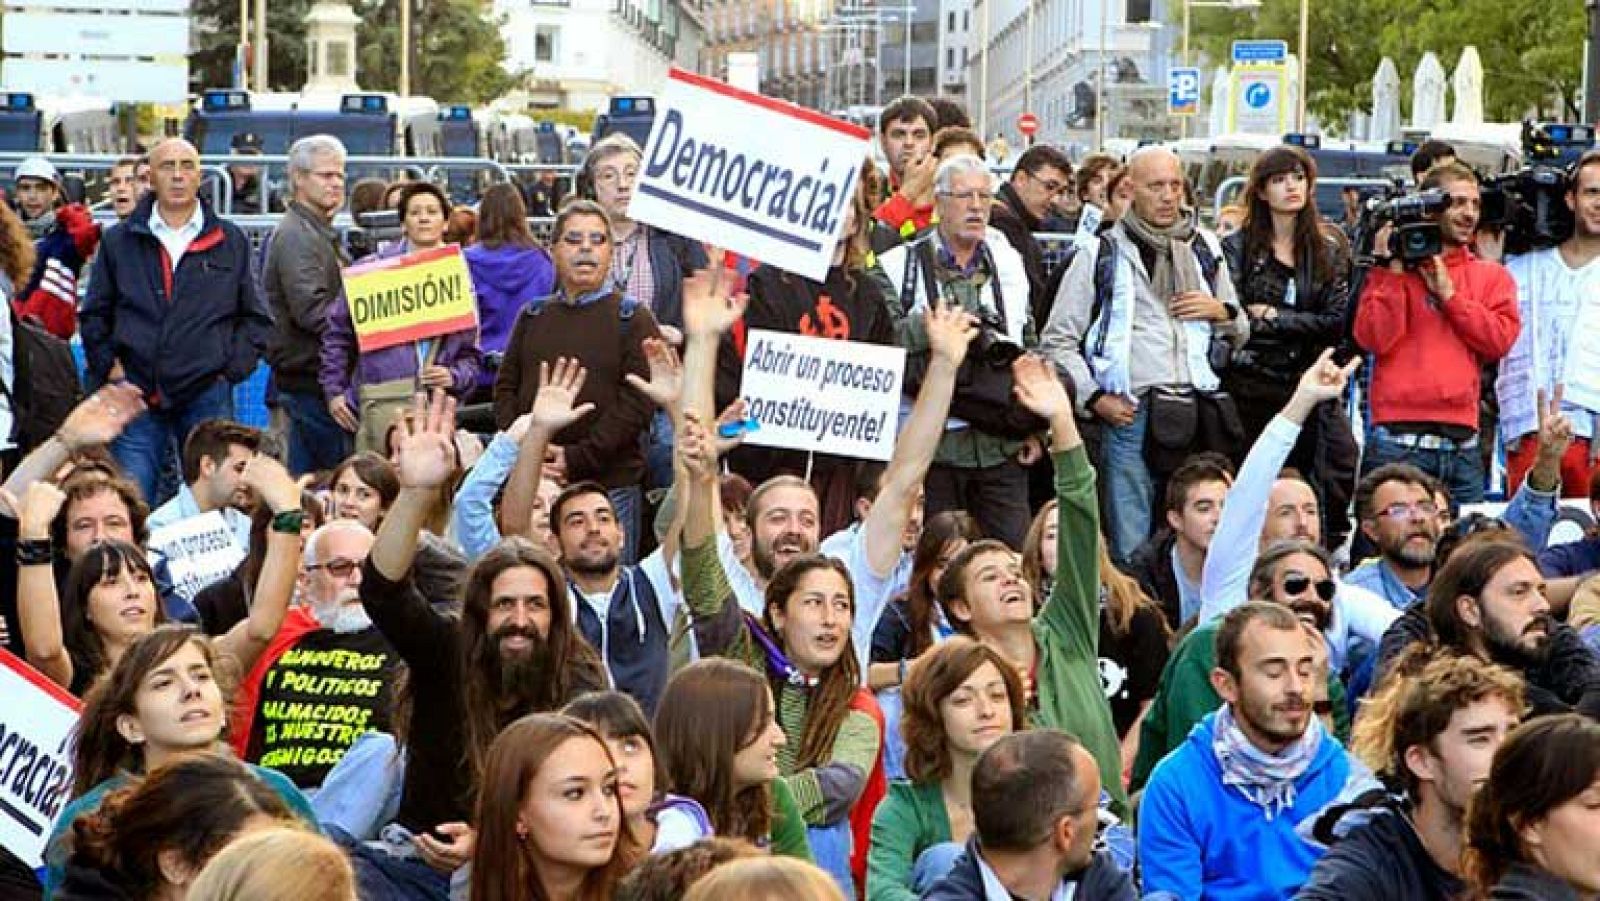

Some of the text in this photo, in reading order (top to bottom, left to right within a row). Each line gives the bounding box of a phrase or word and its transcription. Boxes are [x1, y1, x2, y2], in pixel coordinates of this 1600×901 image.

[646, 108, 855, 234] Democracia!
[354, 273, 461, 324] DIMISIÓN!
[748, 339, 896, 393] Abrir un proceso
